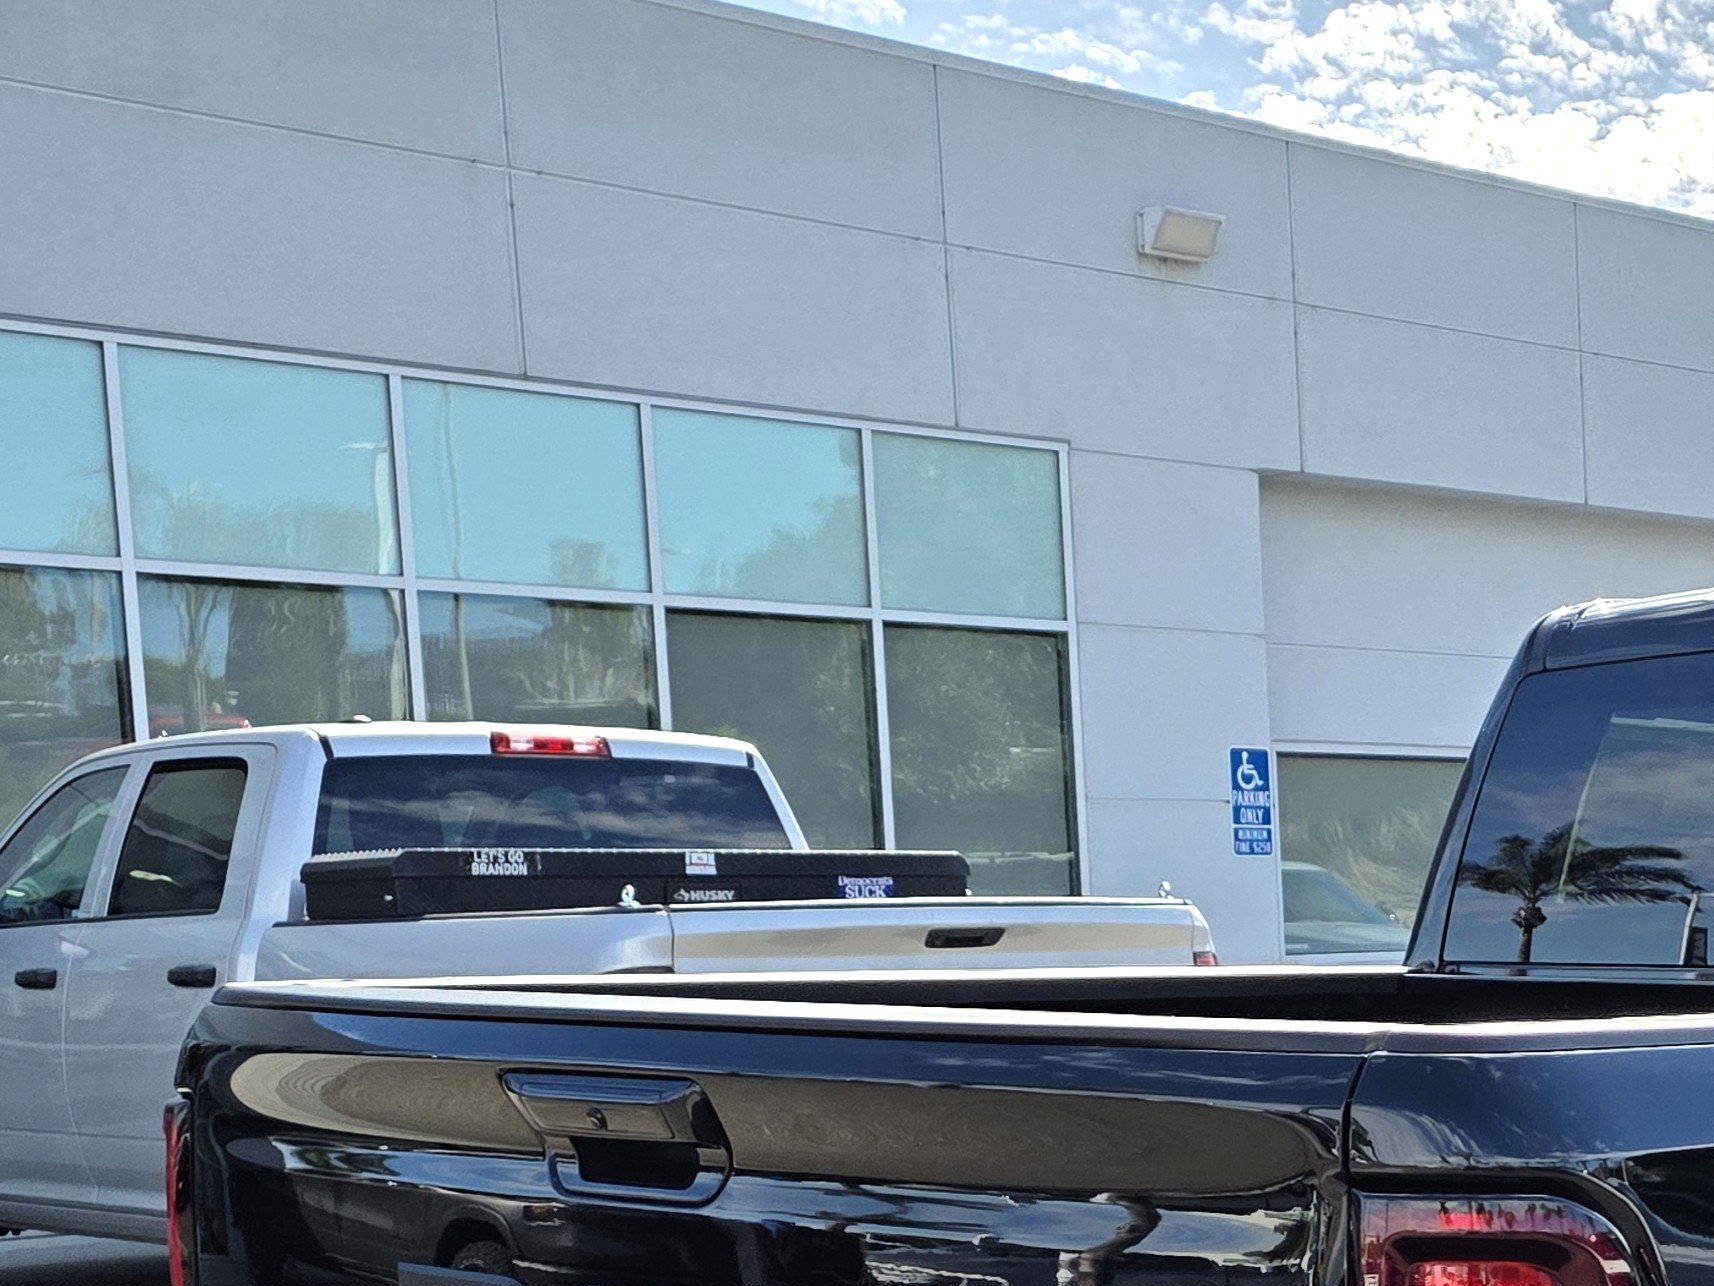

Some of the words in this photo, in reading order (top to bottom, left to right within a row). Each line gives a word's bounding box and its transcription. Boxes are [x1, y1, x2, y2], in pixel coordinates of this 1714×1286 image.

[1232, 790, 1270, 807] PARKING
[1240, 808, 1264, 824] ONLY
[473, 849, 505, 863] LET'S
[508, 850, 524, 863] GO
[471, 862, 528, 876] BRANDON
[690, 890, 735, 901] HUSKY
[845, 885, 887, 898] SUCK
